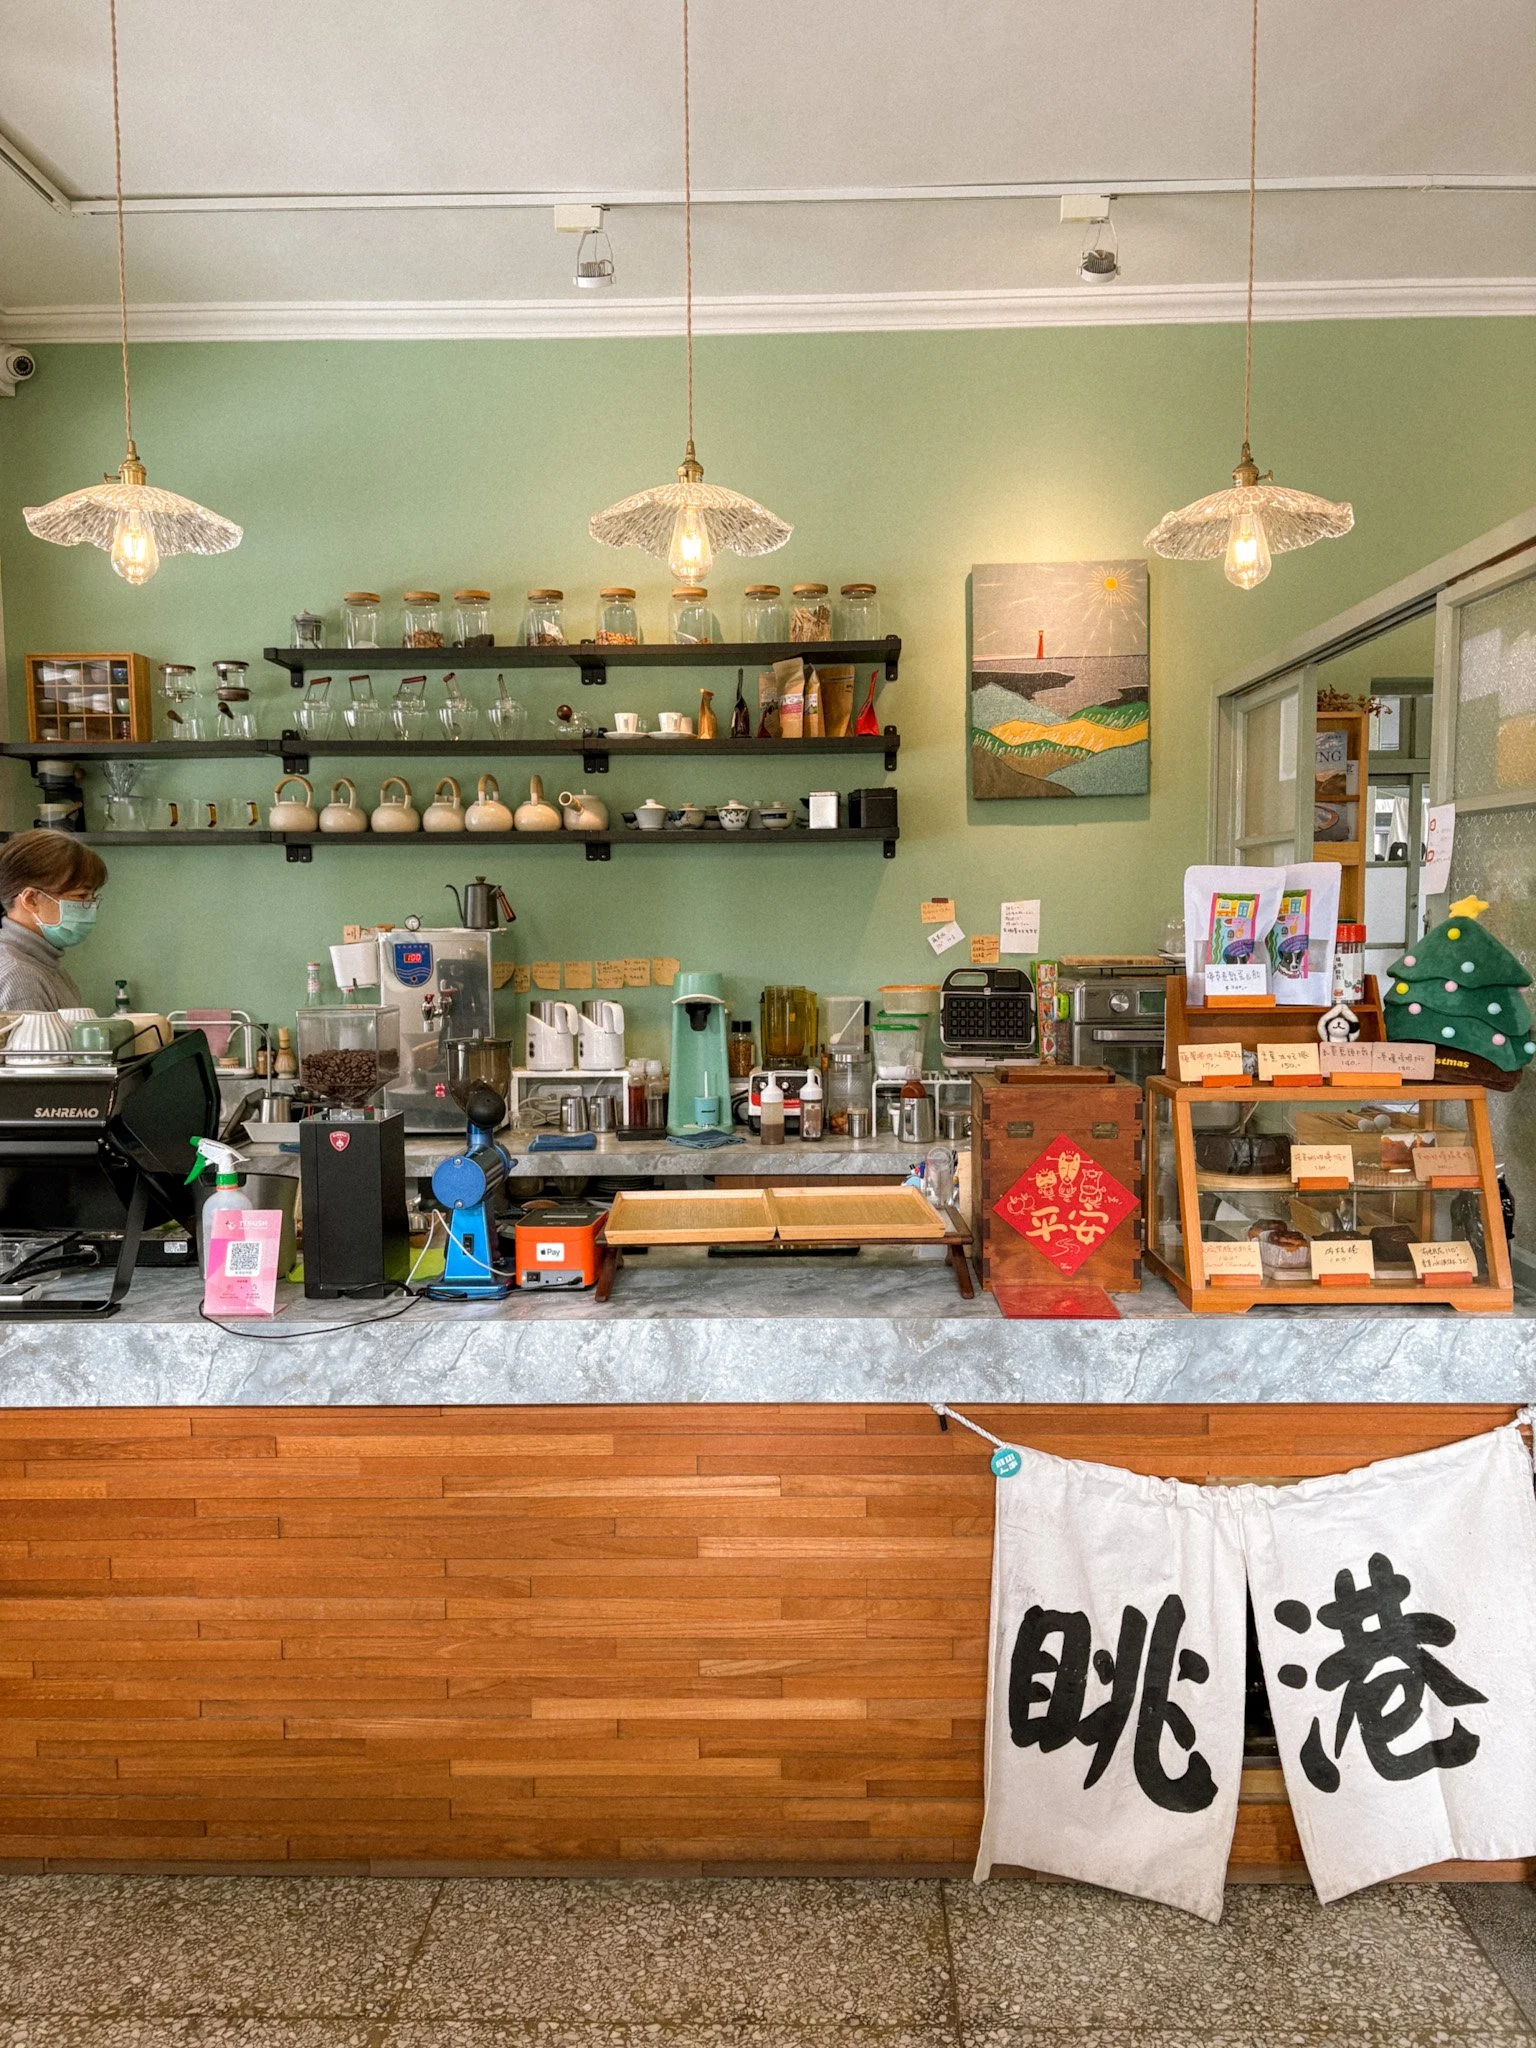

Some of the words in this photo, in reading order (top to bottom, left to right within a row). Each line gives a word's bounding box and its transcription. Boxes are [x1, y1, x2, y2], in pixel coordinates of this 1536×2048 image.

[1434, 1057, 1470, 1069] stmas
[34, 1107, 99, 1118] SANREMO
[1025, 1202, 1110, 1245] 平安
[546, 1248, 561, 1258] Pay
[1008, 1552, 1490, 1814] 眺港
